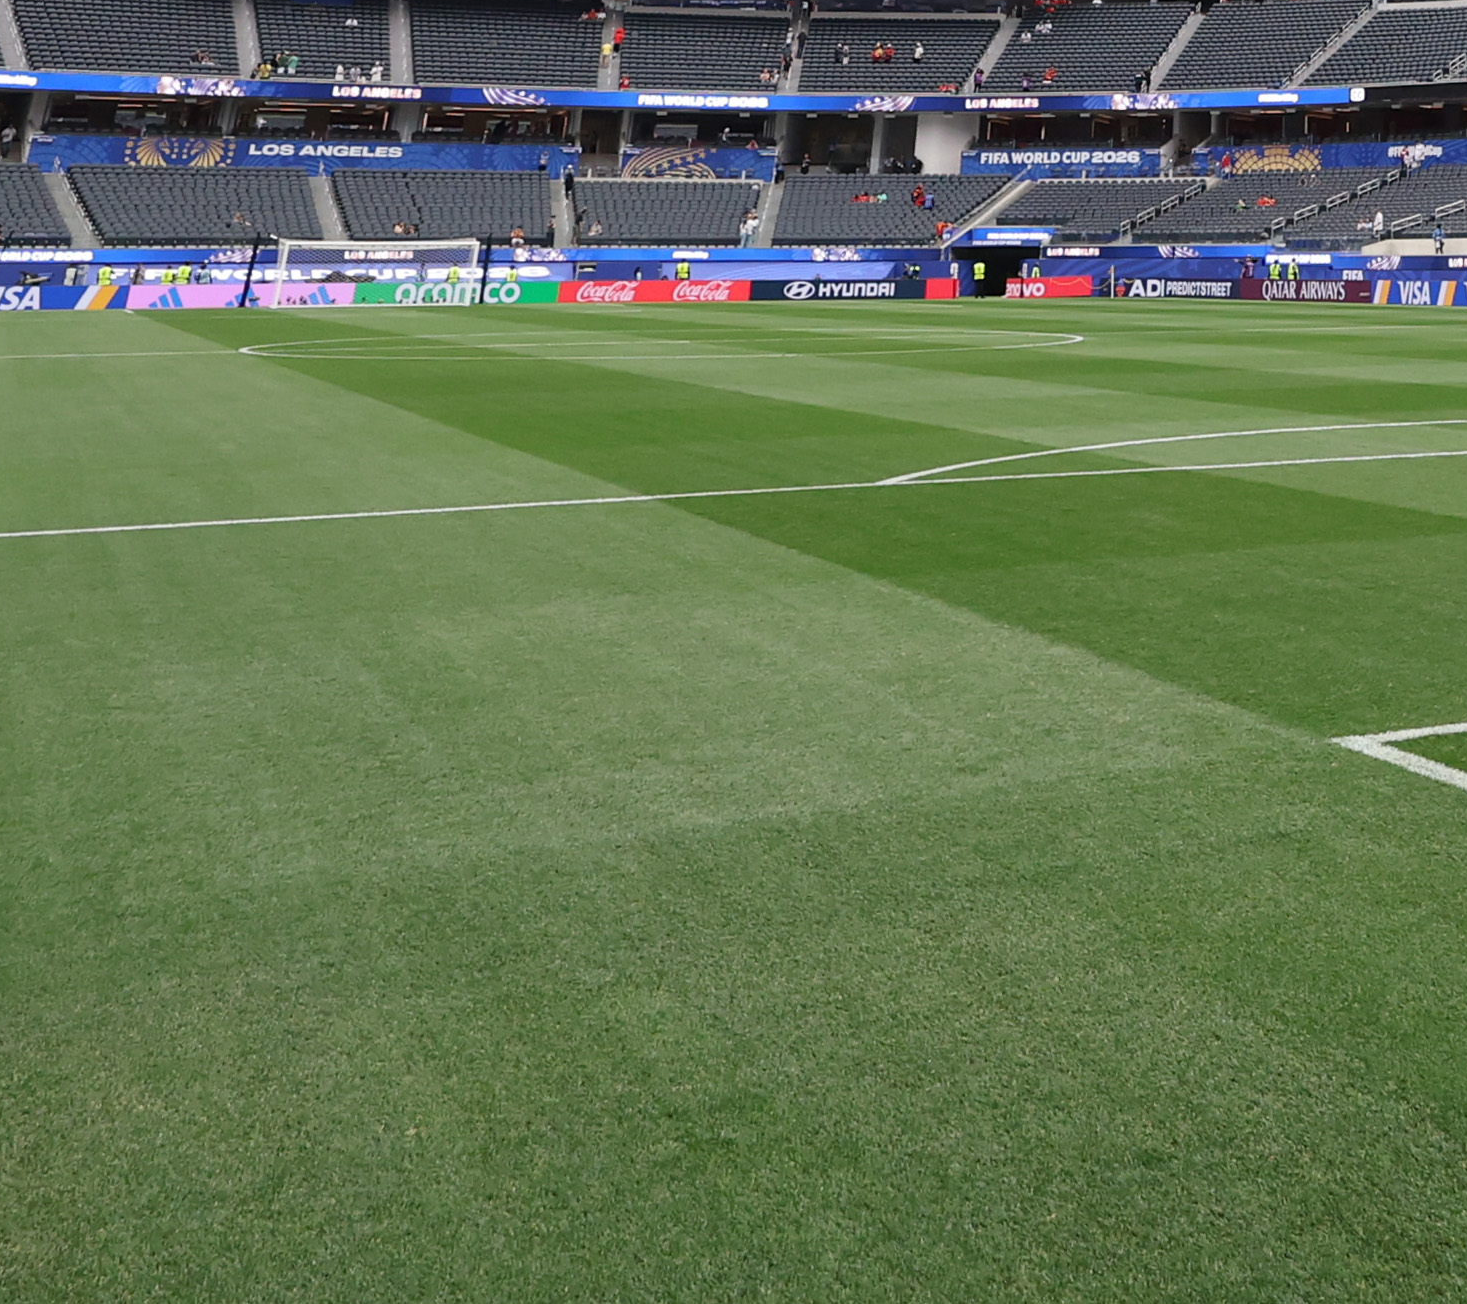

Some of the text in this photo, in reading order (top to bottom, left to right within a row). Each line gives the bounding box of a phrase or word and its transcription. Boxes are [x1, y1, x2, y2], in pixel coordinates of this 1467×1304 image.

[361, 87, 422, 99] ANGELES
[663, 95, 706, 107] WORLD
[248, 143, 403, 158] LOS ANGELES
[980, 151, 1142, 165] FIFA WORLD CUP 2026
[395, 282, 522, 304] aramco
[576, 281, 639, 302] Coca-Cola
[673, 281, 732, 301] Coca-Cola
[818, 282, 896, 297] HYUNDAI
[1128, 279, 1232, 297] ADI PREDICTSTREET
[1262, 280, 1346, 302] QATAR AIRWAYS
[1397, 280, 1431, 305] VISA
